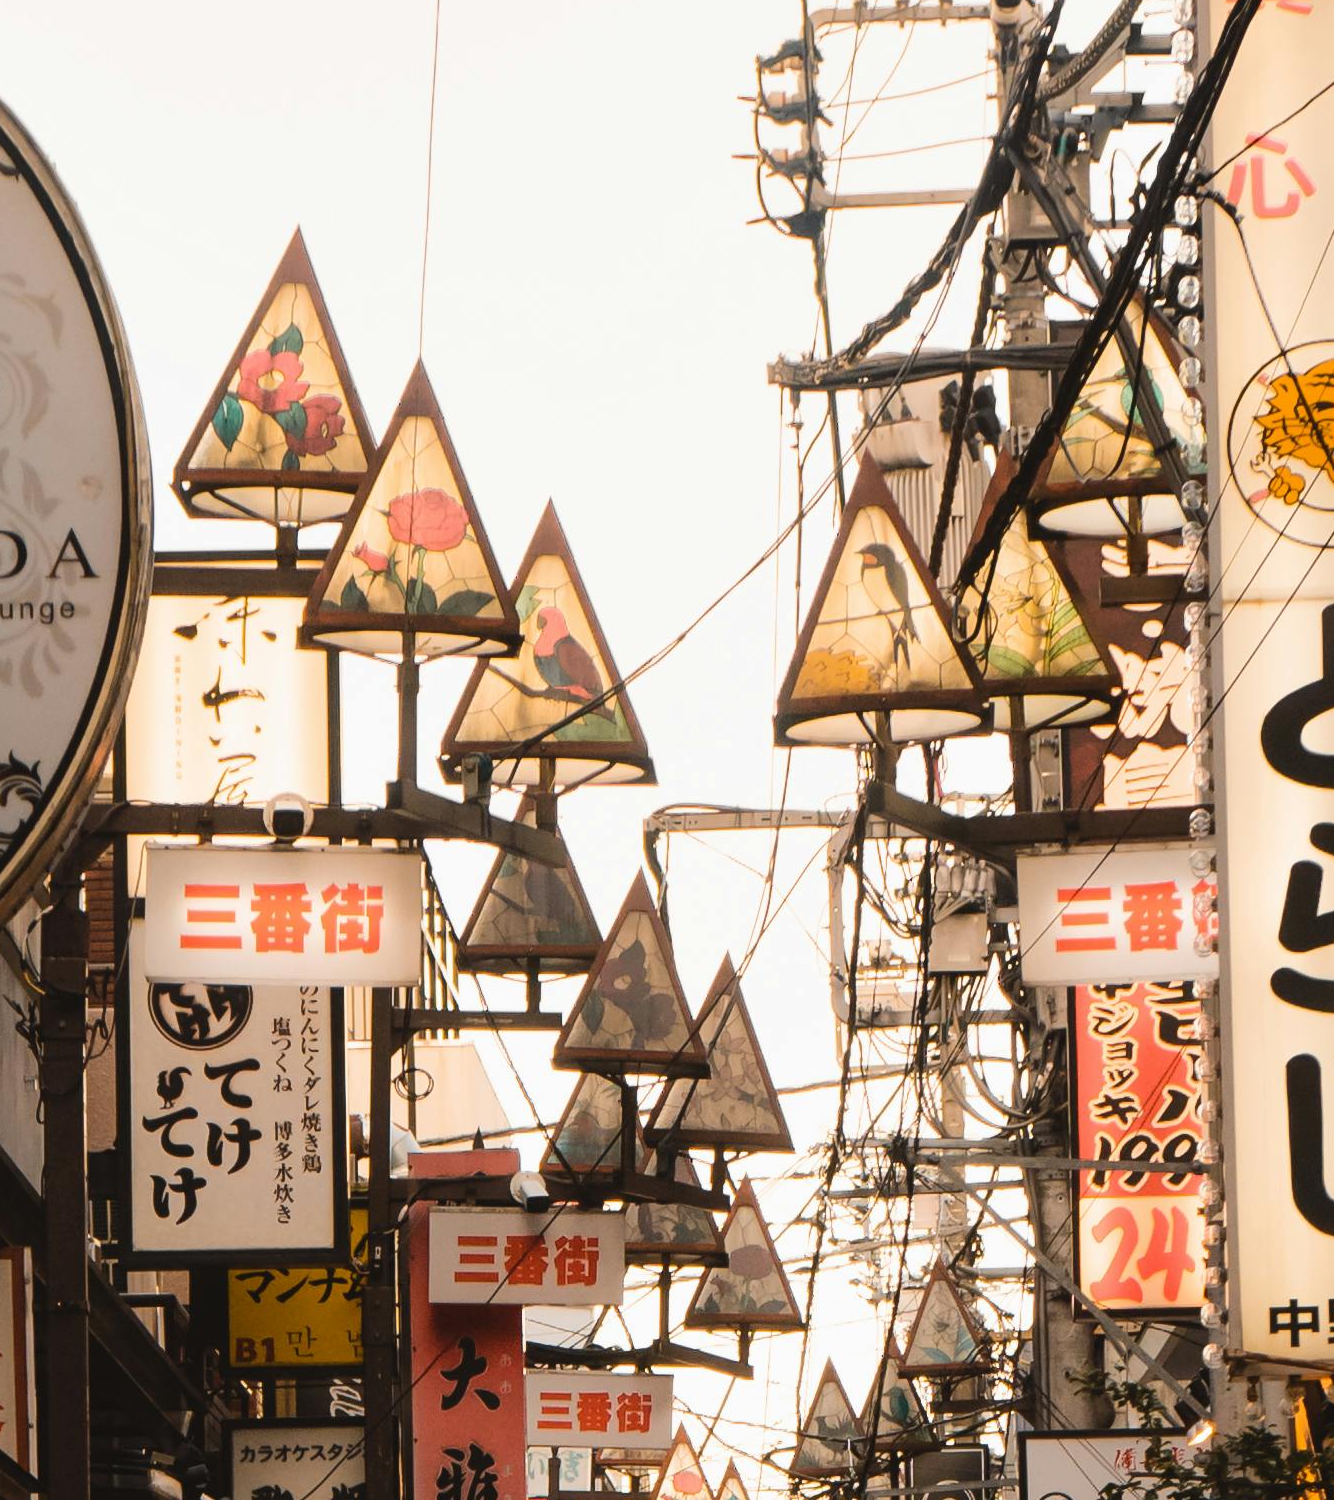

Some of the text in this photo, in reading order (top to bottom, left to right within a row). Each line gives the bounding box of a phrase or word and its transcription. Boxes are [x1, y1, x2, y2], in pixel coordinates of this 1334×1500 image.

[179, 881, 385, 954] 三番街
[204, 1057, 263, 1175] てけ
[270, 1017, 294, 1225] 塩つくね 博多水炊き
[142, 1106, 207, 1225] てけ
[454, 1235, 600, 1287] 三番街
[1091, 1206, 1196, 1303] 24
[235, 1337, 276, 1363] B1
[537, 1392, 653, 1433] 三番街
[240, 1444, 365, 1464] カラオケスタジ
